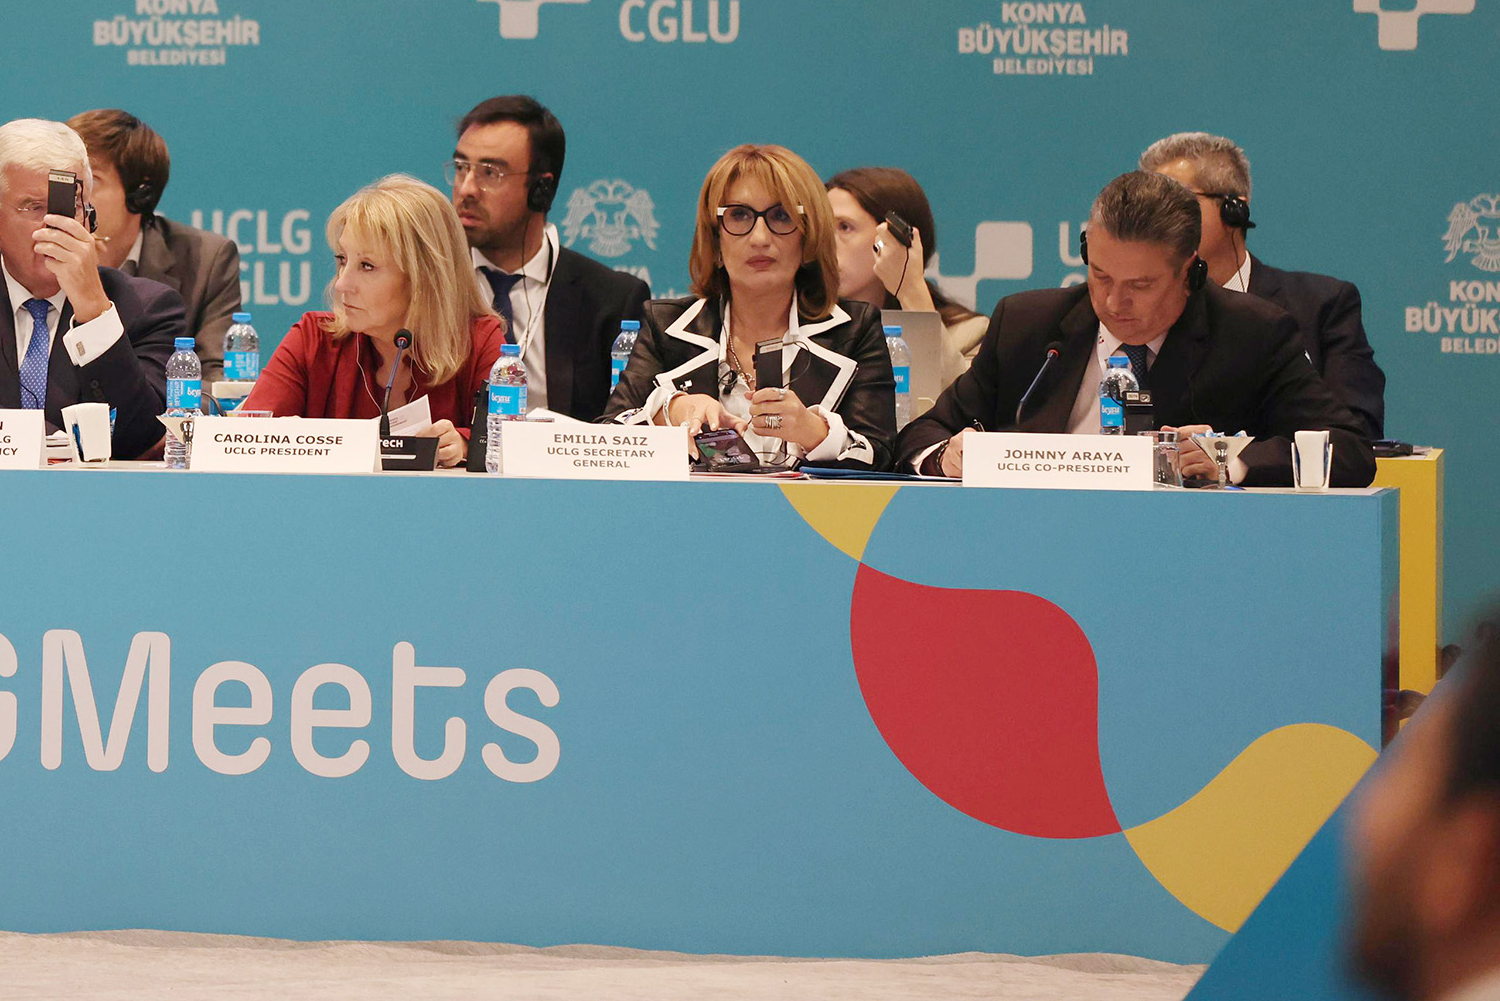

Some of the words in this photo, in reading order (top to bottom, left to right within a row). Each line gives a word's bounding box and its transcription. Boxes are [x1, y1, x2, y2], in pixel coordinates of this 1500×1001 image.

[1001, 2, 1087, 24] KONYA
[92, 14, 260, 50] BÜYÜKŞEHİR
[957, 23, 1129, 59] BÜYÜKŞEHİR
[126, 46, 226, 66] BELEDİYESİ
[992, 55, 1094, 76] BELEDİYESİ
[1440, 337, 1500, 354] BELED
[214, 433, 290, 444] CAROLINA
[296, 435, 343, 445] COSSE
[553, 433, 607, 445] EMILIA
[612, 435, 648, 446] SAIZ
[223, 446, 256, 456] UCLG
[260, 447, 332, 456] PRESIDENT
[547, 447, 581, 457] UCLG
[584, 448, 655, 459] SECRETARY
[1003, 449, 1068, 460] JOHNNY
[1072, 450, 1124, 461] ARAYA
[572, 459, 631, 469] GENERAL
[997, 463, 1031, 472] UCLG
[1034, 463, 1131, 473] CO-PRESIDENT
